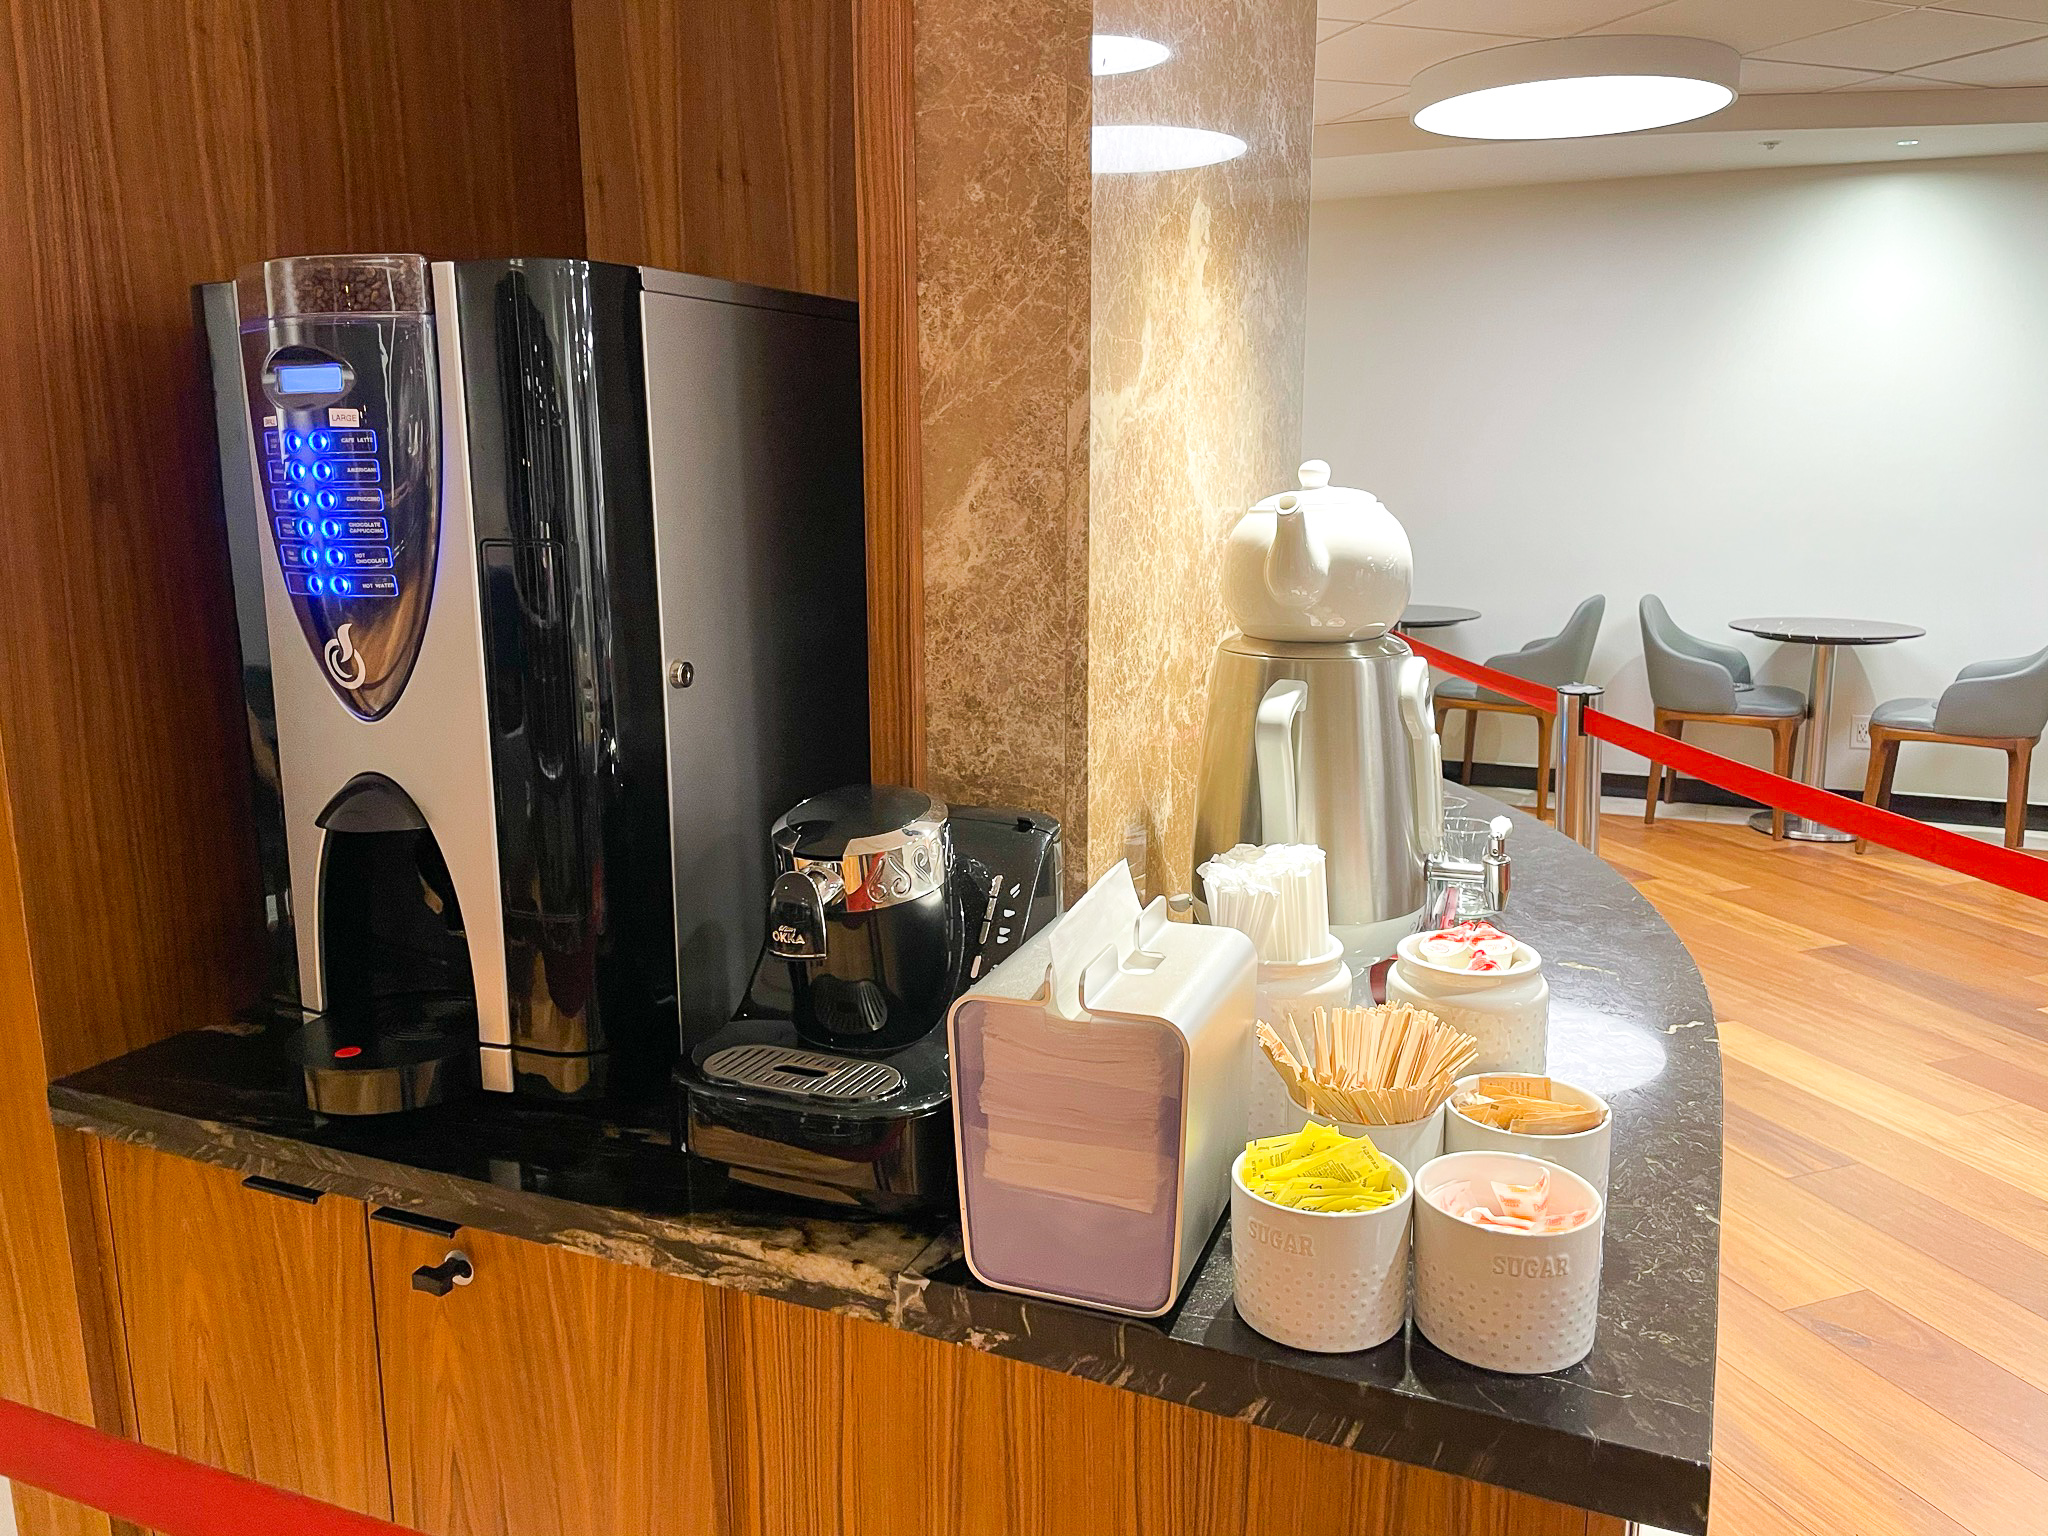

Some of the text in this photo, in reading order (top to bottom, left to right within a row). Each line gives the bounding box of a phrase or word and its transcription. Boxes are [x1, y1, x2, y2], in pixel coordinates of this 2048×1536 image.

[772, 931, 805, 944] OKKA
[1248, 1220, 1314, 1257] SUGAR
[1492, 1254, 1570, 1280] SUGAR
